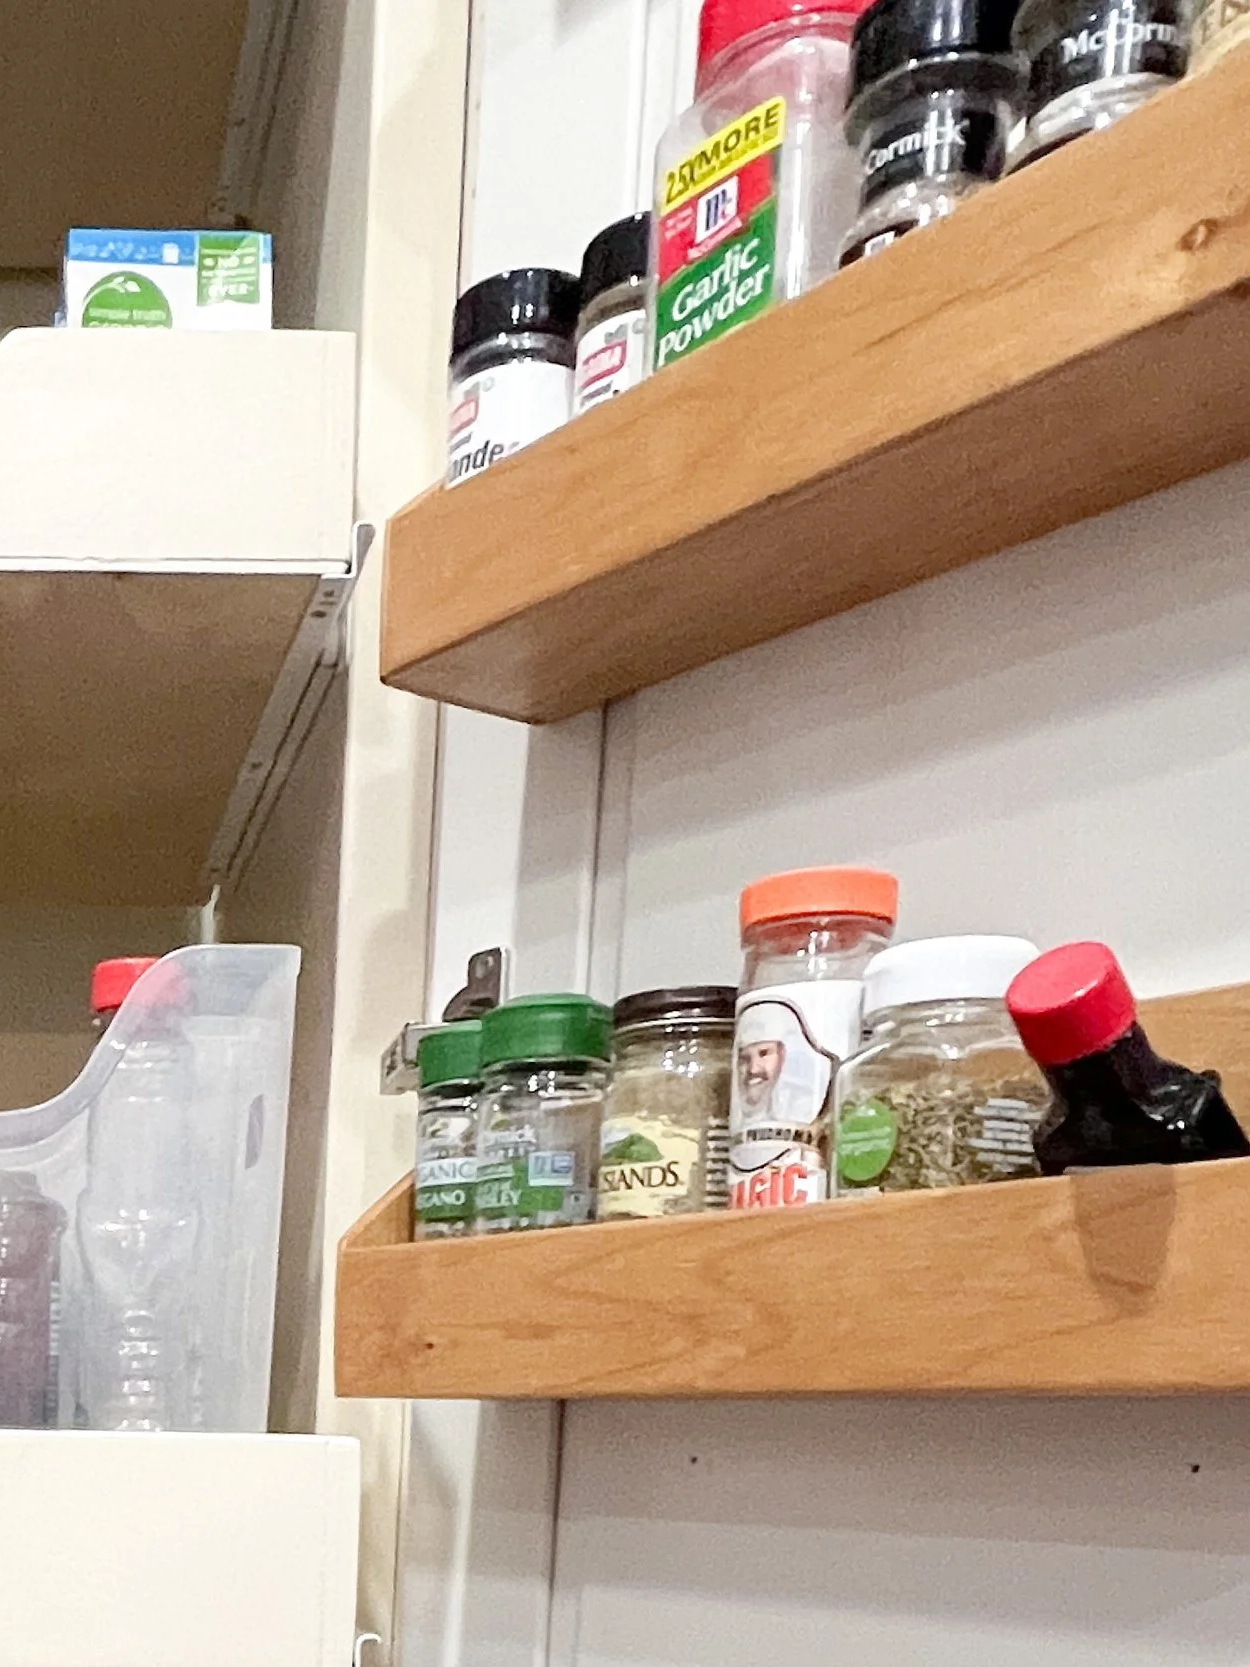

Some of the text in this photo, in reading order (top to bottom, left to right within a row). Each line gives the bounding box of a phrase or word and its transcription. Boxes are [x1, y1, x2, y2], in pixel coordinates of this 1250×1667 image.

[700, 102, 781, 166] MORE
[656, 264, 770, 368] Powder
[672, 238, 760, 321] Garlic
